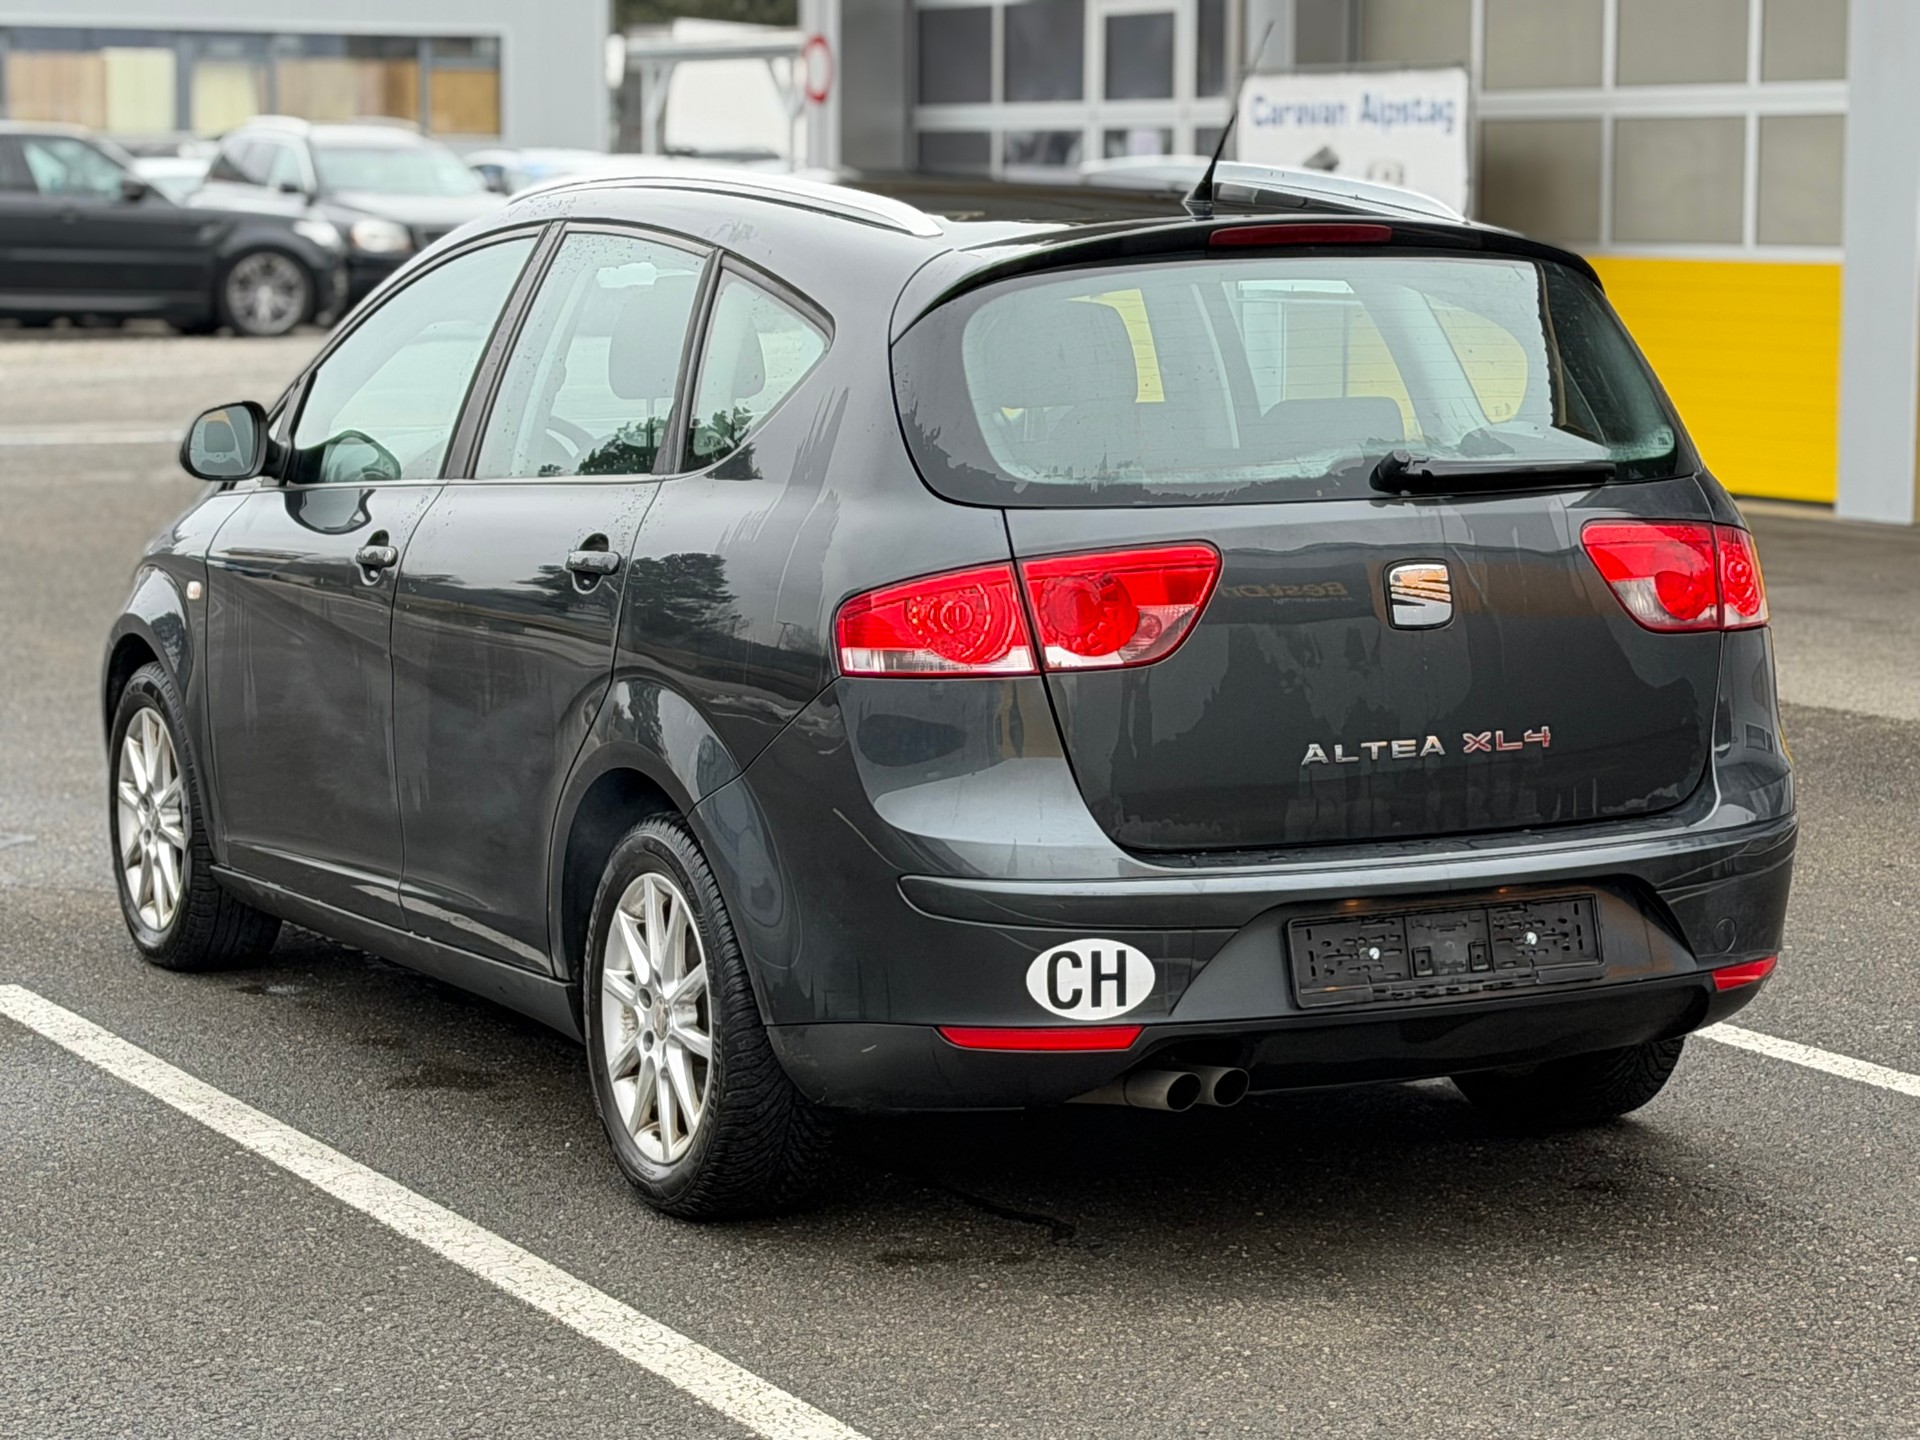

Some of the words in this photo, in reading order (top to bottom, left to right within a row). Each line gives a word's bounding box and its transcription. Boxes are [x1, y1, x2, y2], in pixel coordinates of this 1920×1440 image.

[1252, 94, 1348, 127] Caravan
[1300, 735, 1446, 766] ALTEA
[1462, 725, 1551, 753] XL4
[1046, 949, 1128, 1011] CH
